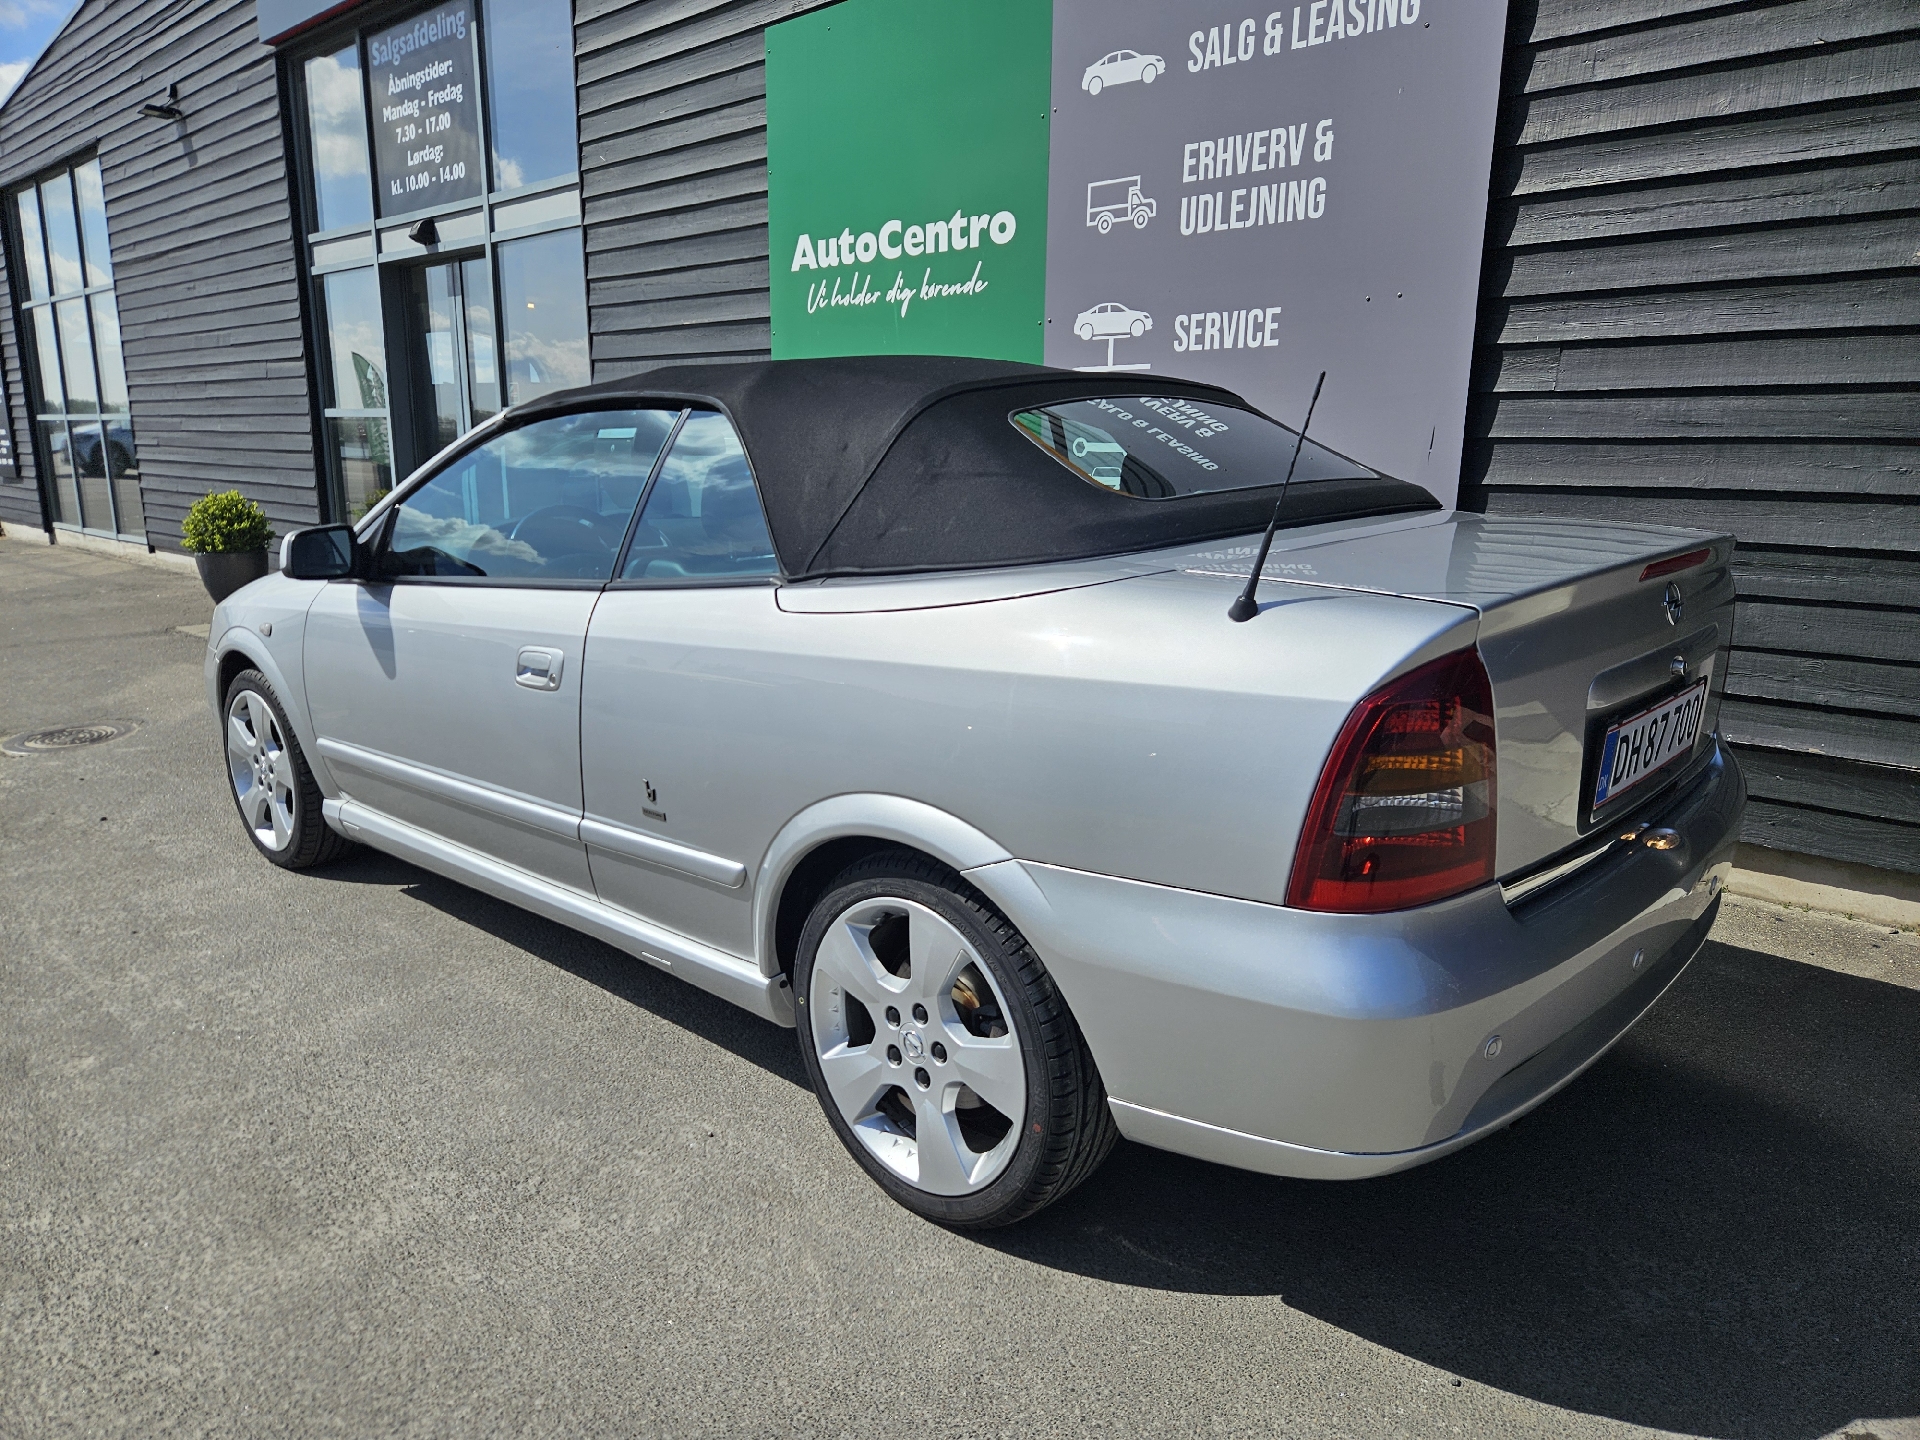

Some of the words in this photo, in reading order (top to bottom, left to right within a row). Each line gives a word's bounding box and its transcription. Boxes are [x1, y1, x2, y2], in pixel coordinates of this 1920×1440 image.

[371, 10, 466, 66] Salgsafdeling
[1187, 18, 1256, 73] SALG
[1263, 11, 1283, 57] &
[1290, 0, 1421, 50] LEASING
[383, 98, 419, 123] Mandag
[427, 83, 463, 108] Fredag
[388, 59, 453, 96] Åbningstider:
[395, 123, 416, 144] 7.30
[425, 111, 451, 135] 17.00
[1182, 122, 1308, 183] ERHVERV
[1313, 118, 1335, 163] &
[391, 180, 404, 196] kl.
[405, 172, 430, 193] 10.00
[439, 161, 466, 184] 14.00
[407, 144, 444, 167] Lørdag:
[1180, 176, 1327, 236] UDLEJNING
[791, 209, 1017, 272] AutoCentro
[807, 279, 828, 314] Vi
[830, 271, 881, 307] holder
[885, 270, 917, 319] dig
[919, 260, 989, 301] kørende
[1173, 306, 1282, 352] SERVICE
[1611, 725, 1645, 788] DH
[1643, 711, 1670, 769] 87
[1667, 694, 1700, 753] 700
[1598, 774, 1609, 790] DK
